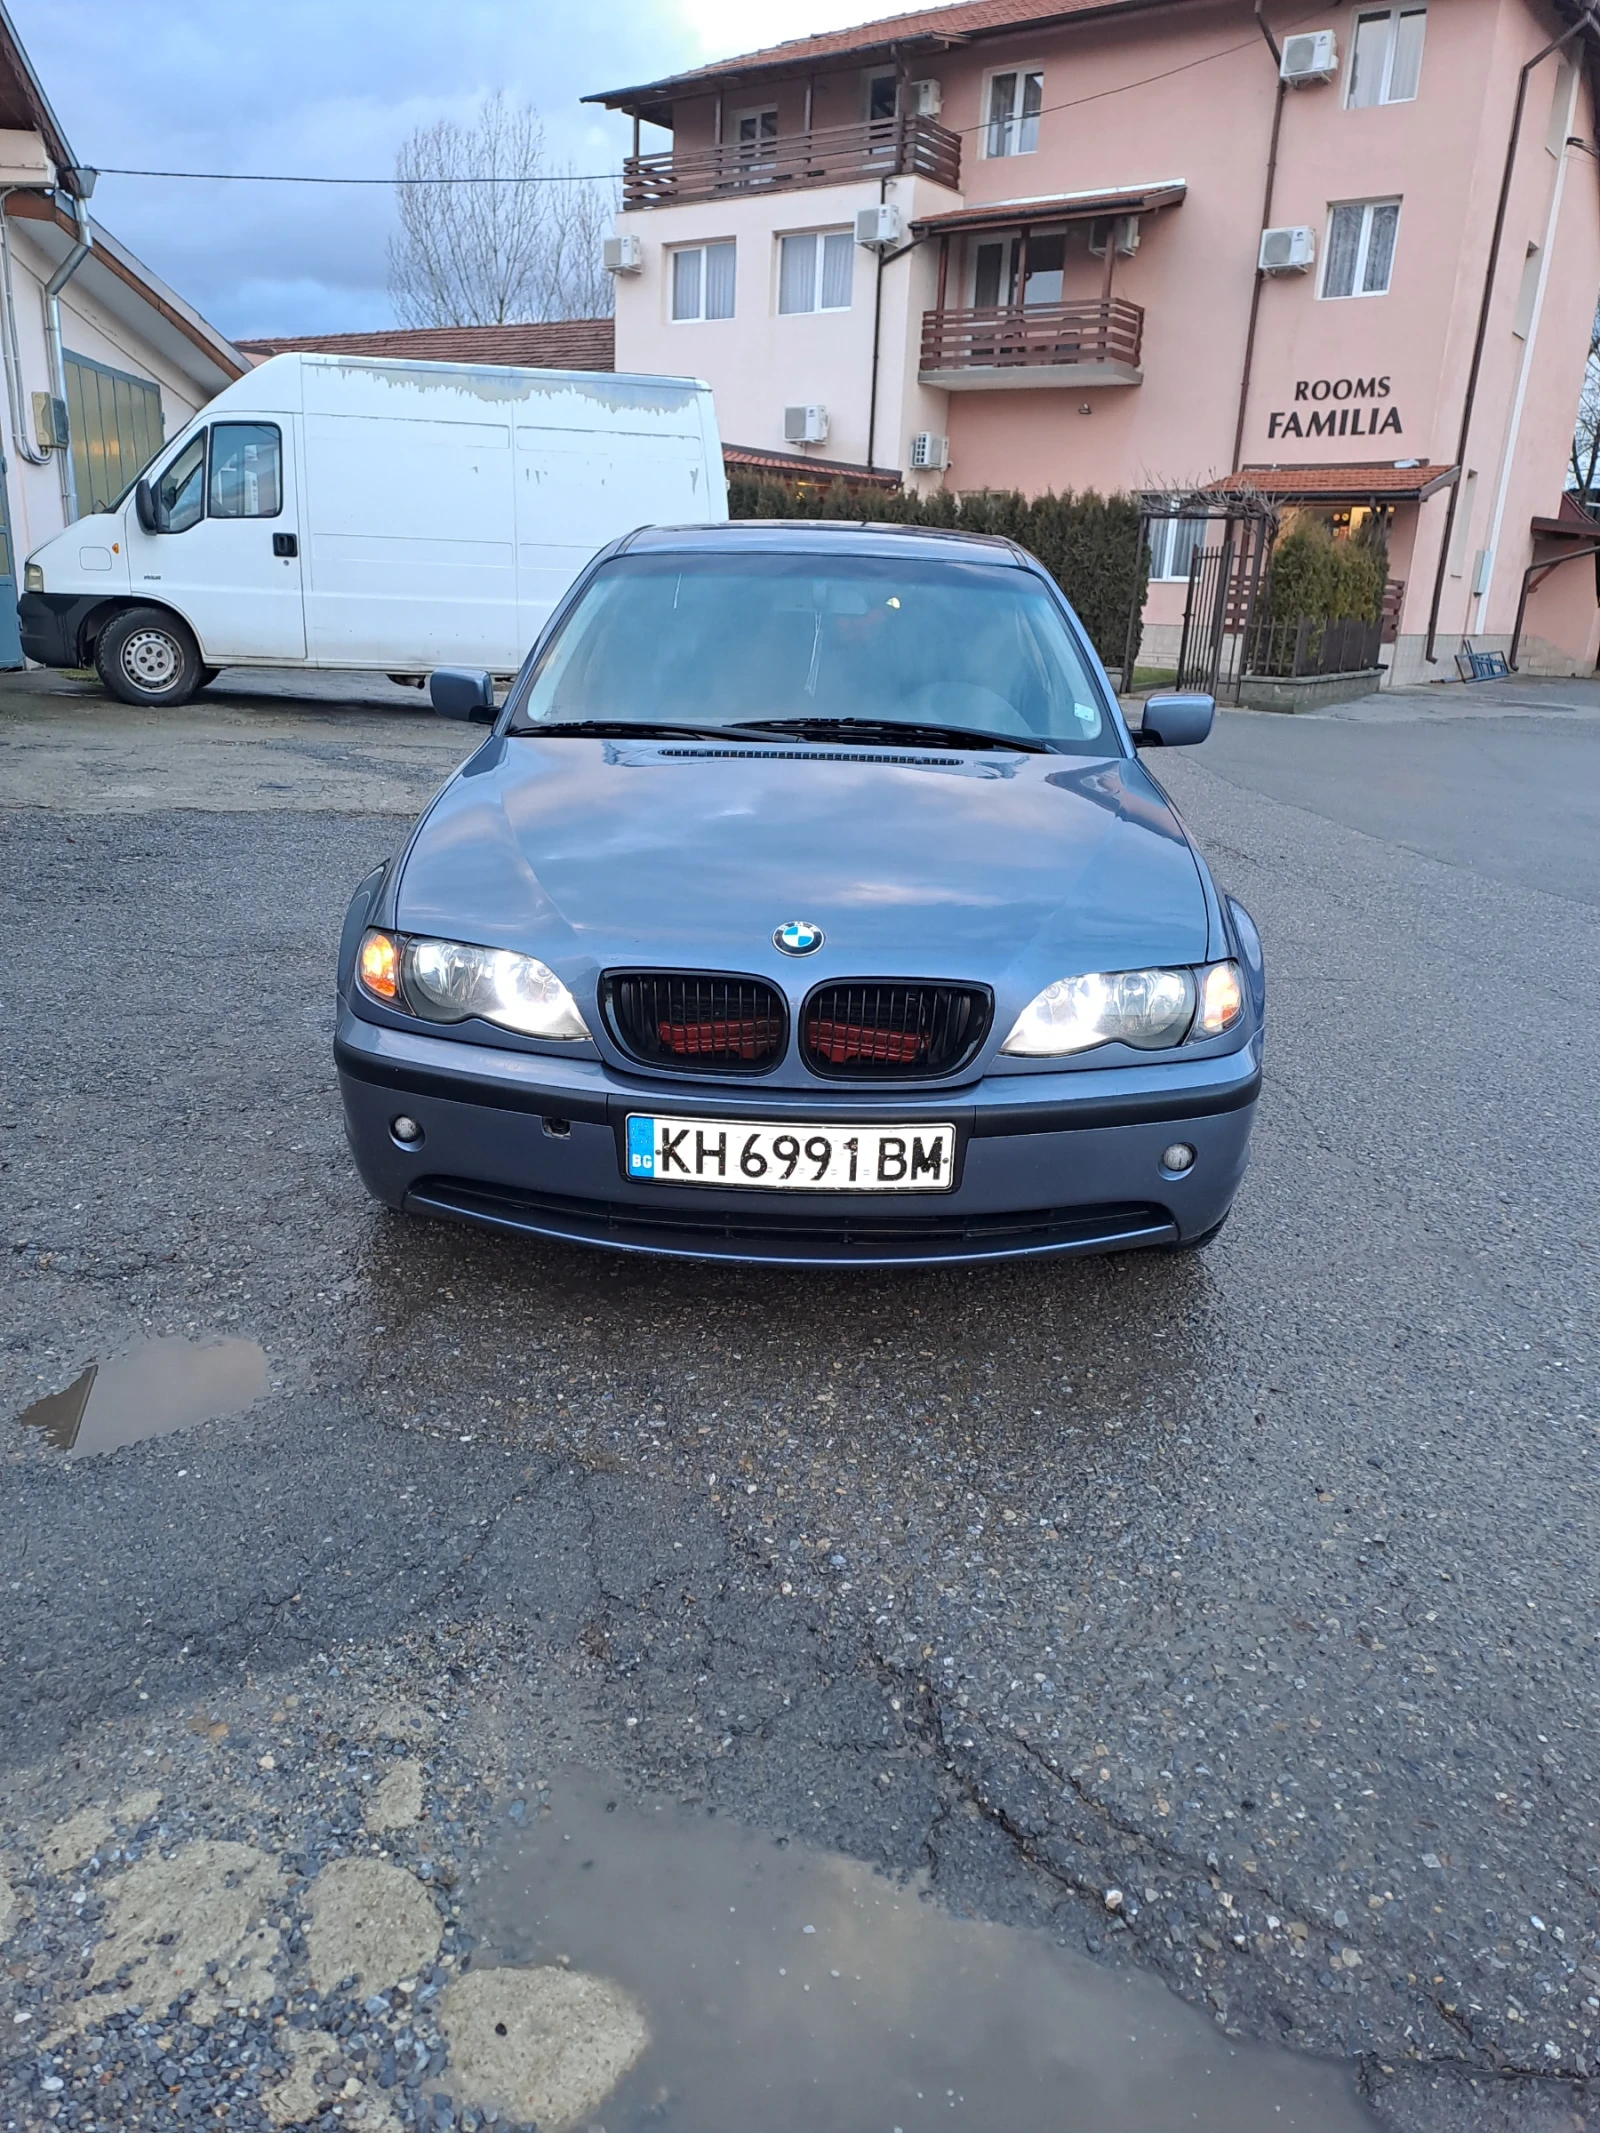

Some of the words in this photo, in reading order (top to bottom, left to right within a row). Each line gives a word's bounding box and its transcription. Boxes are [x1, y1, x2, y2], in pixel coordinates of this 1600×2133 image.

[1294, 376, 1391, 401] ROOMS
[1267, 406, 1403, 439] FAMILIA
[632, 1153, 653, 1169] BG
